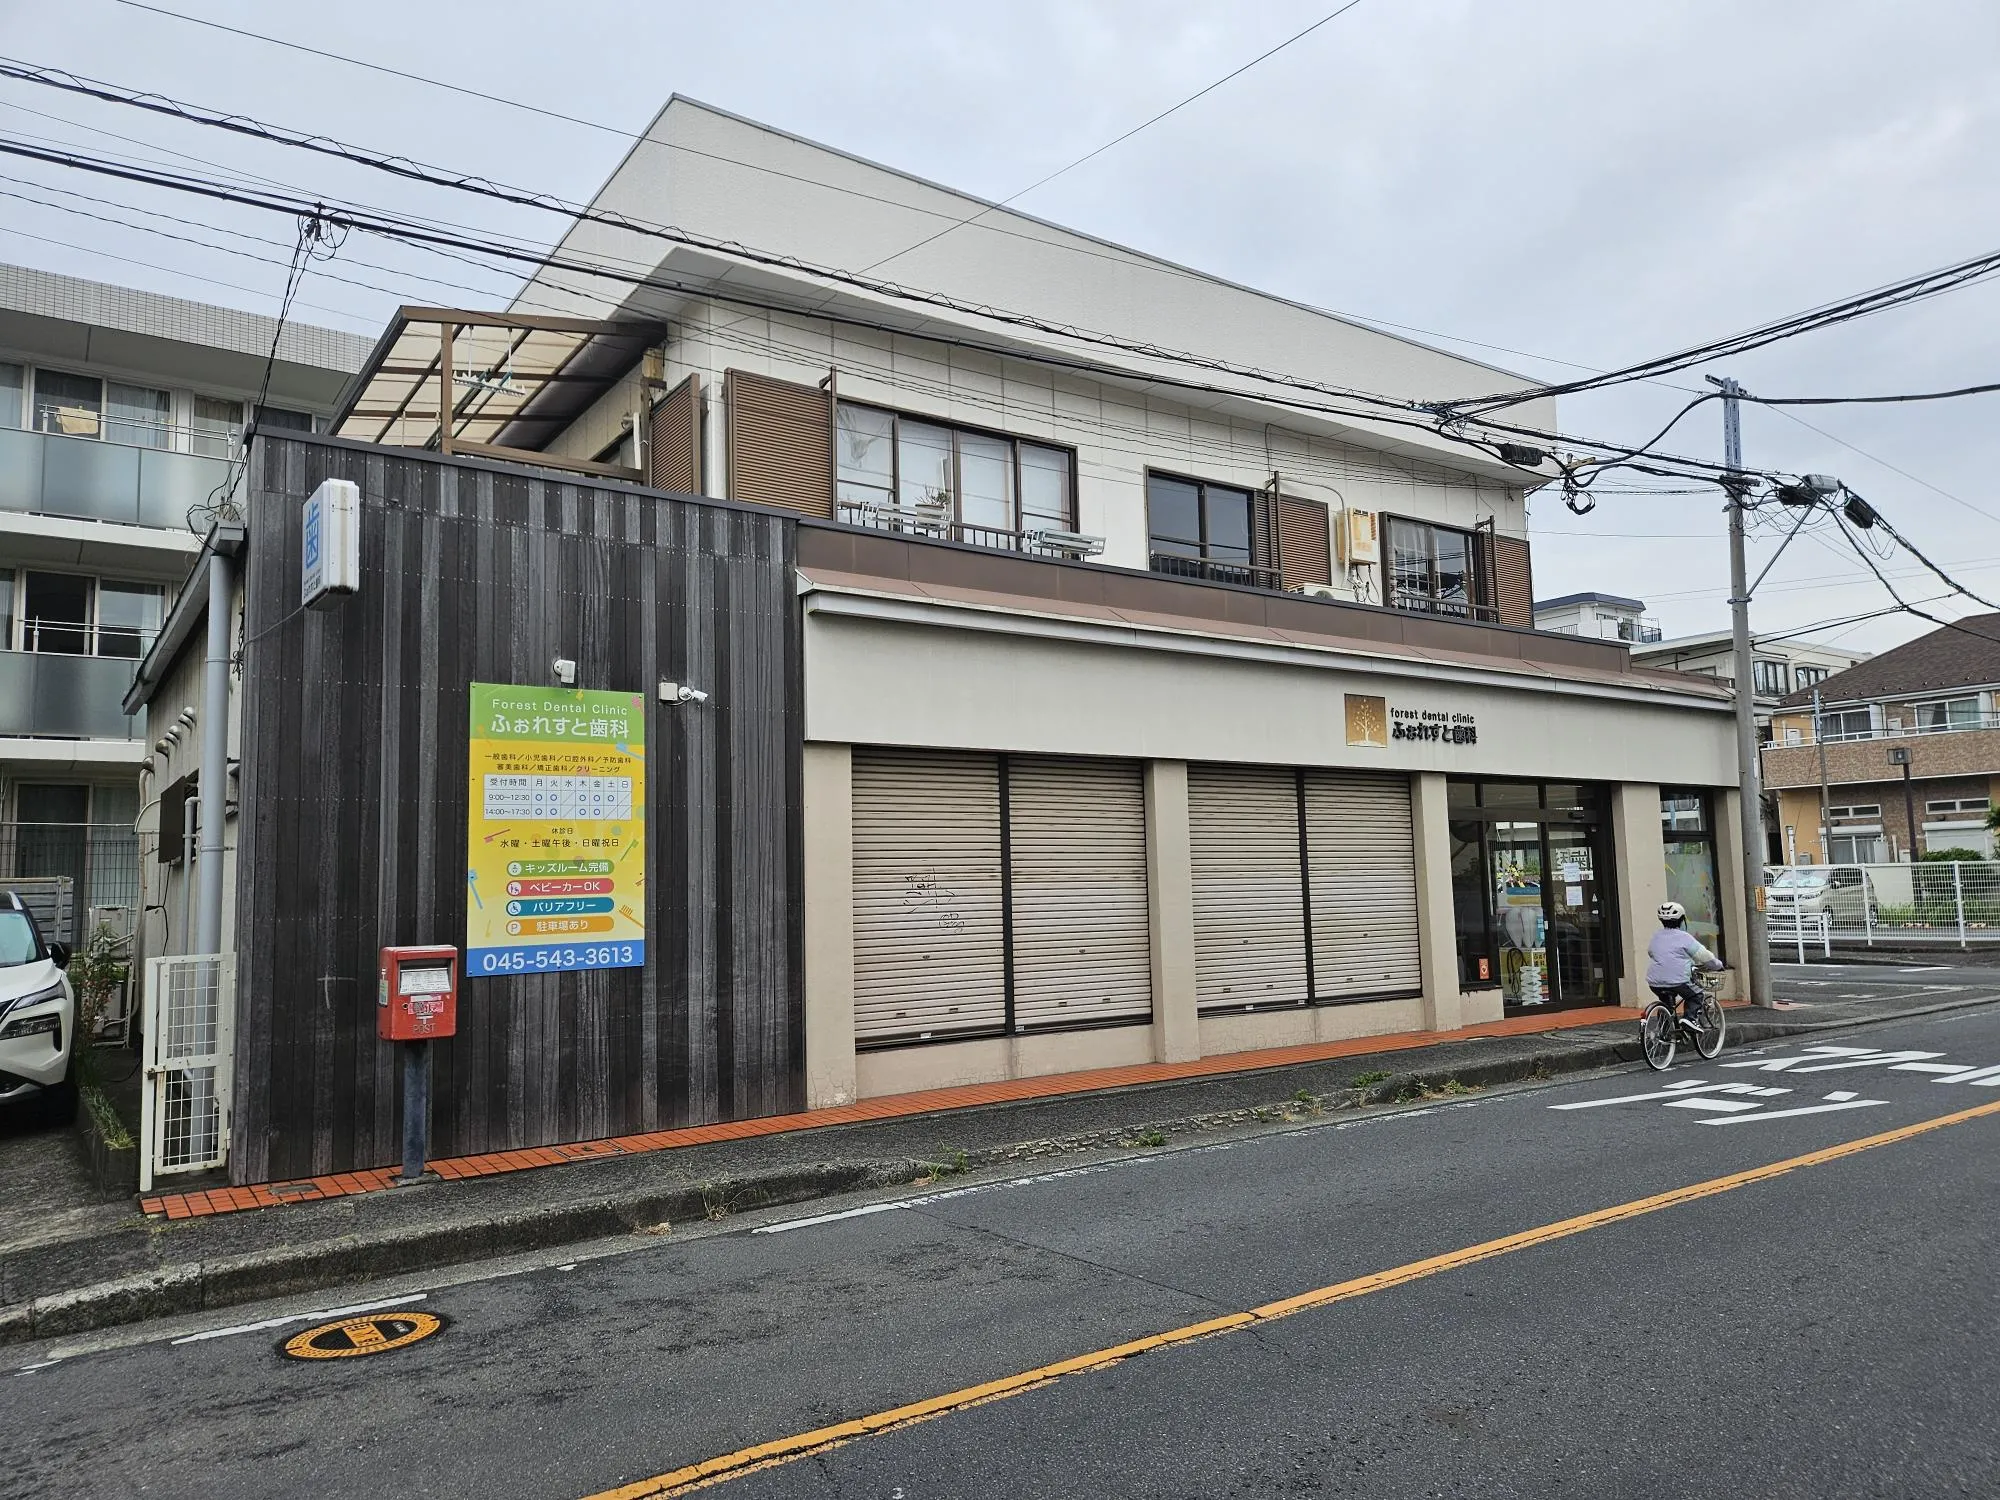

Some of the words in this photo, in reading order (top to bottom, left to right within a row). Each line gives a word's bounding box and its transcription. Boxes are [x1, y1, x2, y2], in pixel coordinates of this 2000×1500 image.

[305, 501, 320, 569] 歯
[492, 699, 537, 710] Forest
[544, 702, 586, 713] Dental
[592, 704, 628, 716] Clinic
[1390, 708, 1418, 720] forest
[1422, 710, 1449, 722] dental
[1452, 713, 1475, 724] clinic
[491, 714, 629, 739] ふぉれすと歯科
[1392, 721, 1478, 744] ふぉれすと歯科
[490, 778, 527, 787] 受付時間
[536, 779, 543, 787] 月
[564, 780, 573, 788] 水
[579, 780, 587, 788] 木
[593, 780, 601, 788] 金
[608, 780, 615, 788] 土
[552, 827, 574, 835] 休診日
[525, 862, 609, 873] キッズルーム完備
[530, 881, 600, 892] ベビーカーOK
[533, 902, 596, 912] バリアフリー
[536, 920, 588, 932] 駐車場あり
[483, 946, 633, 971] 045-543-3613
